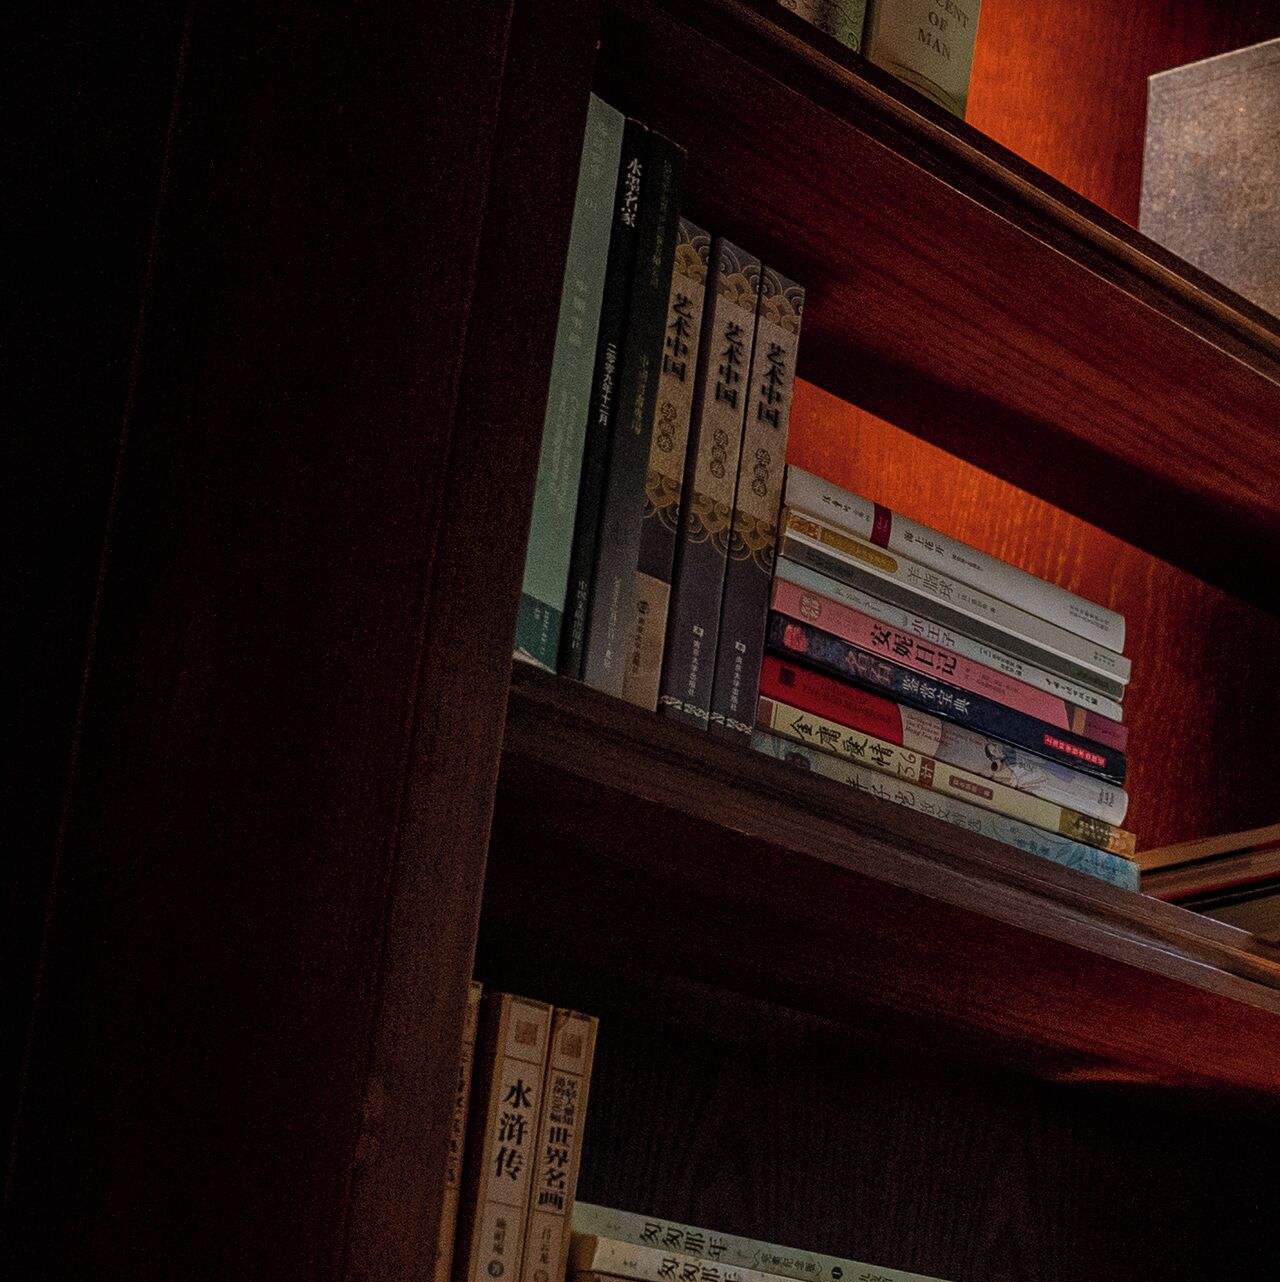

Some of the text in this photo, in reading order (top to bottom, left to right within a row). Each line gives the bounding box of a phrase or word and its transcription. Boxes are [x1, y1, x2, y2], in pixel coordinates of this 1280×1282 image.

[917, 27, 951, 60] MAN
[927, 11, 949, 31] OF
[661, 291, 692, 383] 艺术中国
[714, 320, 745, 410] 艺术中国
[757, 341, 787, 429] 艺术中国
[903, 530, 945, 556] 海上花开
[907, 565, 955, 600] 羊脂球
[870, 623, 958, 677] 安妮日记
[911, 618, 957, 649] 小王子
[494, 1078, 533, 1182] 水浒传
[538, 1126, 573, 1211] 世界名画
[639, 1221, 728, 1261] 匆匆那年
